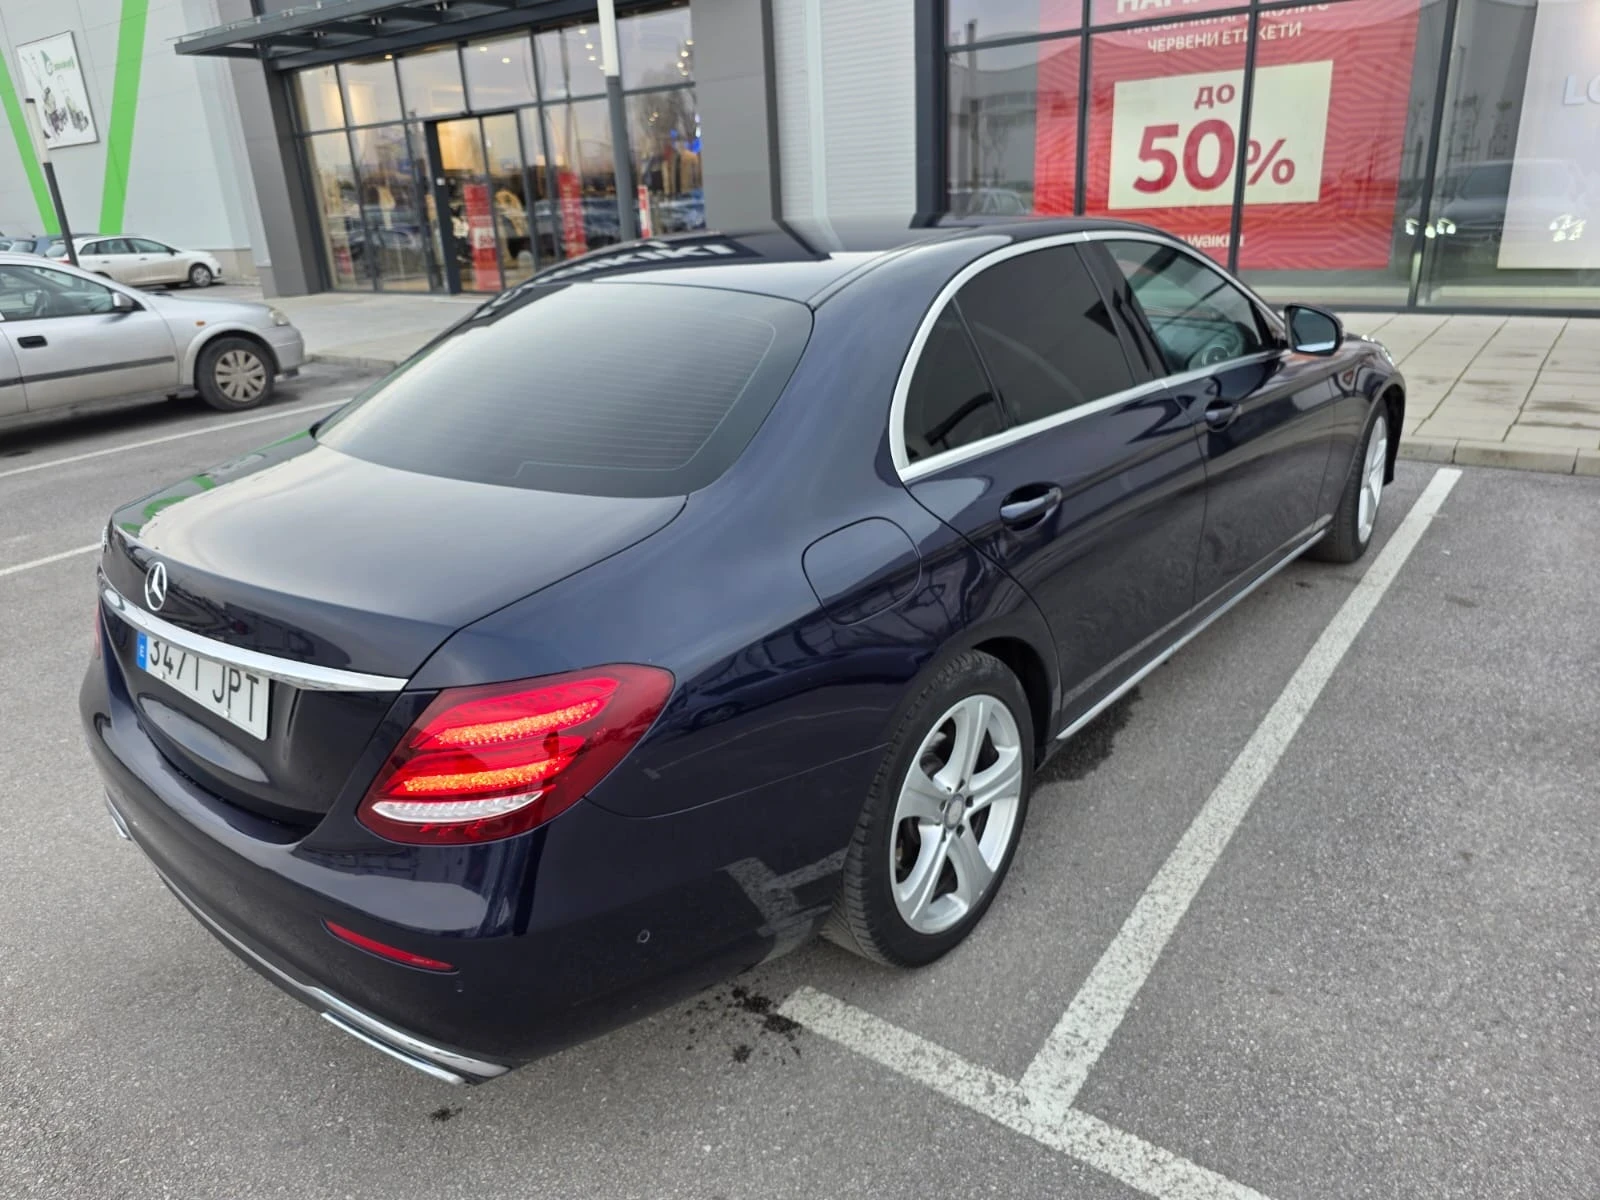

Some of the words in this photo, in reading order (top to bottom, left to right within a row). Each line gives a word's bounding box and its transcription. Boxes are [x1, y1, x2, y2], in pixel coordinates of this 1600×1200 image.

[1147, 31, 1219, 53] ЧЕРВЕНИ
[1132, 118, 1296, 195] 50%
[150, 640, 199, 691] 3471
[212, 665, 260, 722] JPT
